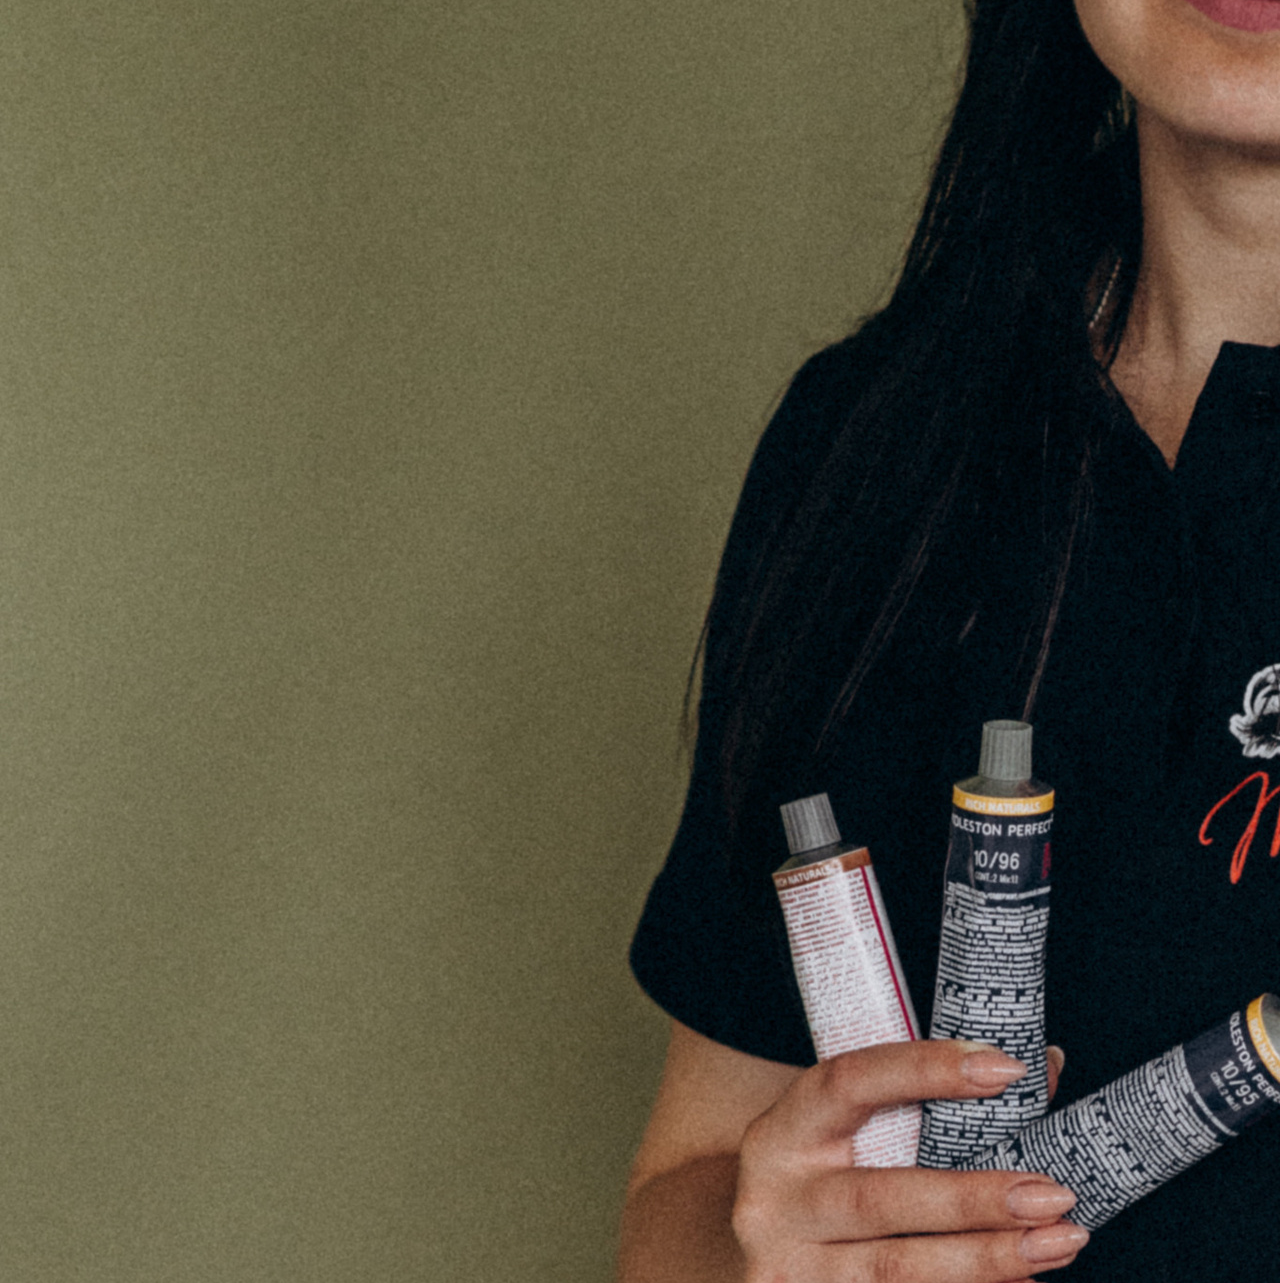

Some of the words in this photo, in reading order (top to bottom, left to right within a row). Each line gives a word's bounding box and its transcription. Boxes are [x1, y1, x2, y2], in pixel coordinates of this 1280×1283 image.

[988, 801, 1041, 813] NATURALS
[974, 850, 1020, 870] 10/96
[1220, 1059, 1260, 1106] 10/95
